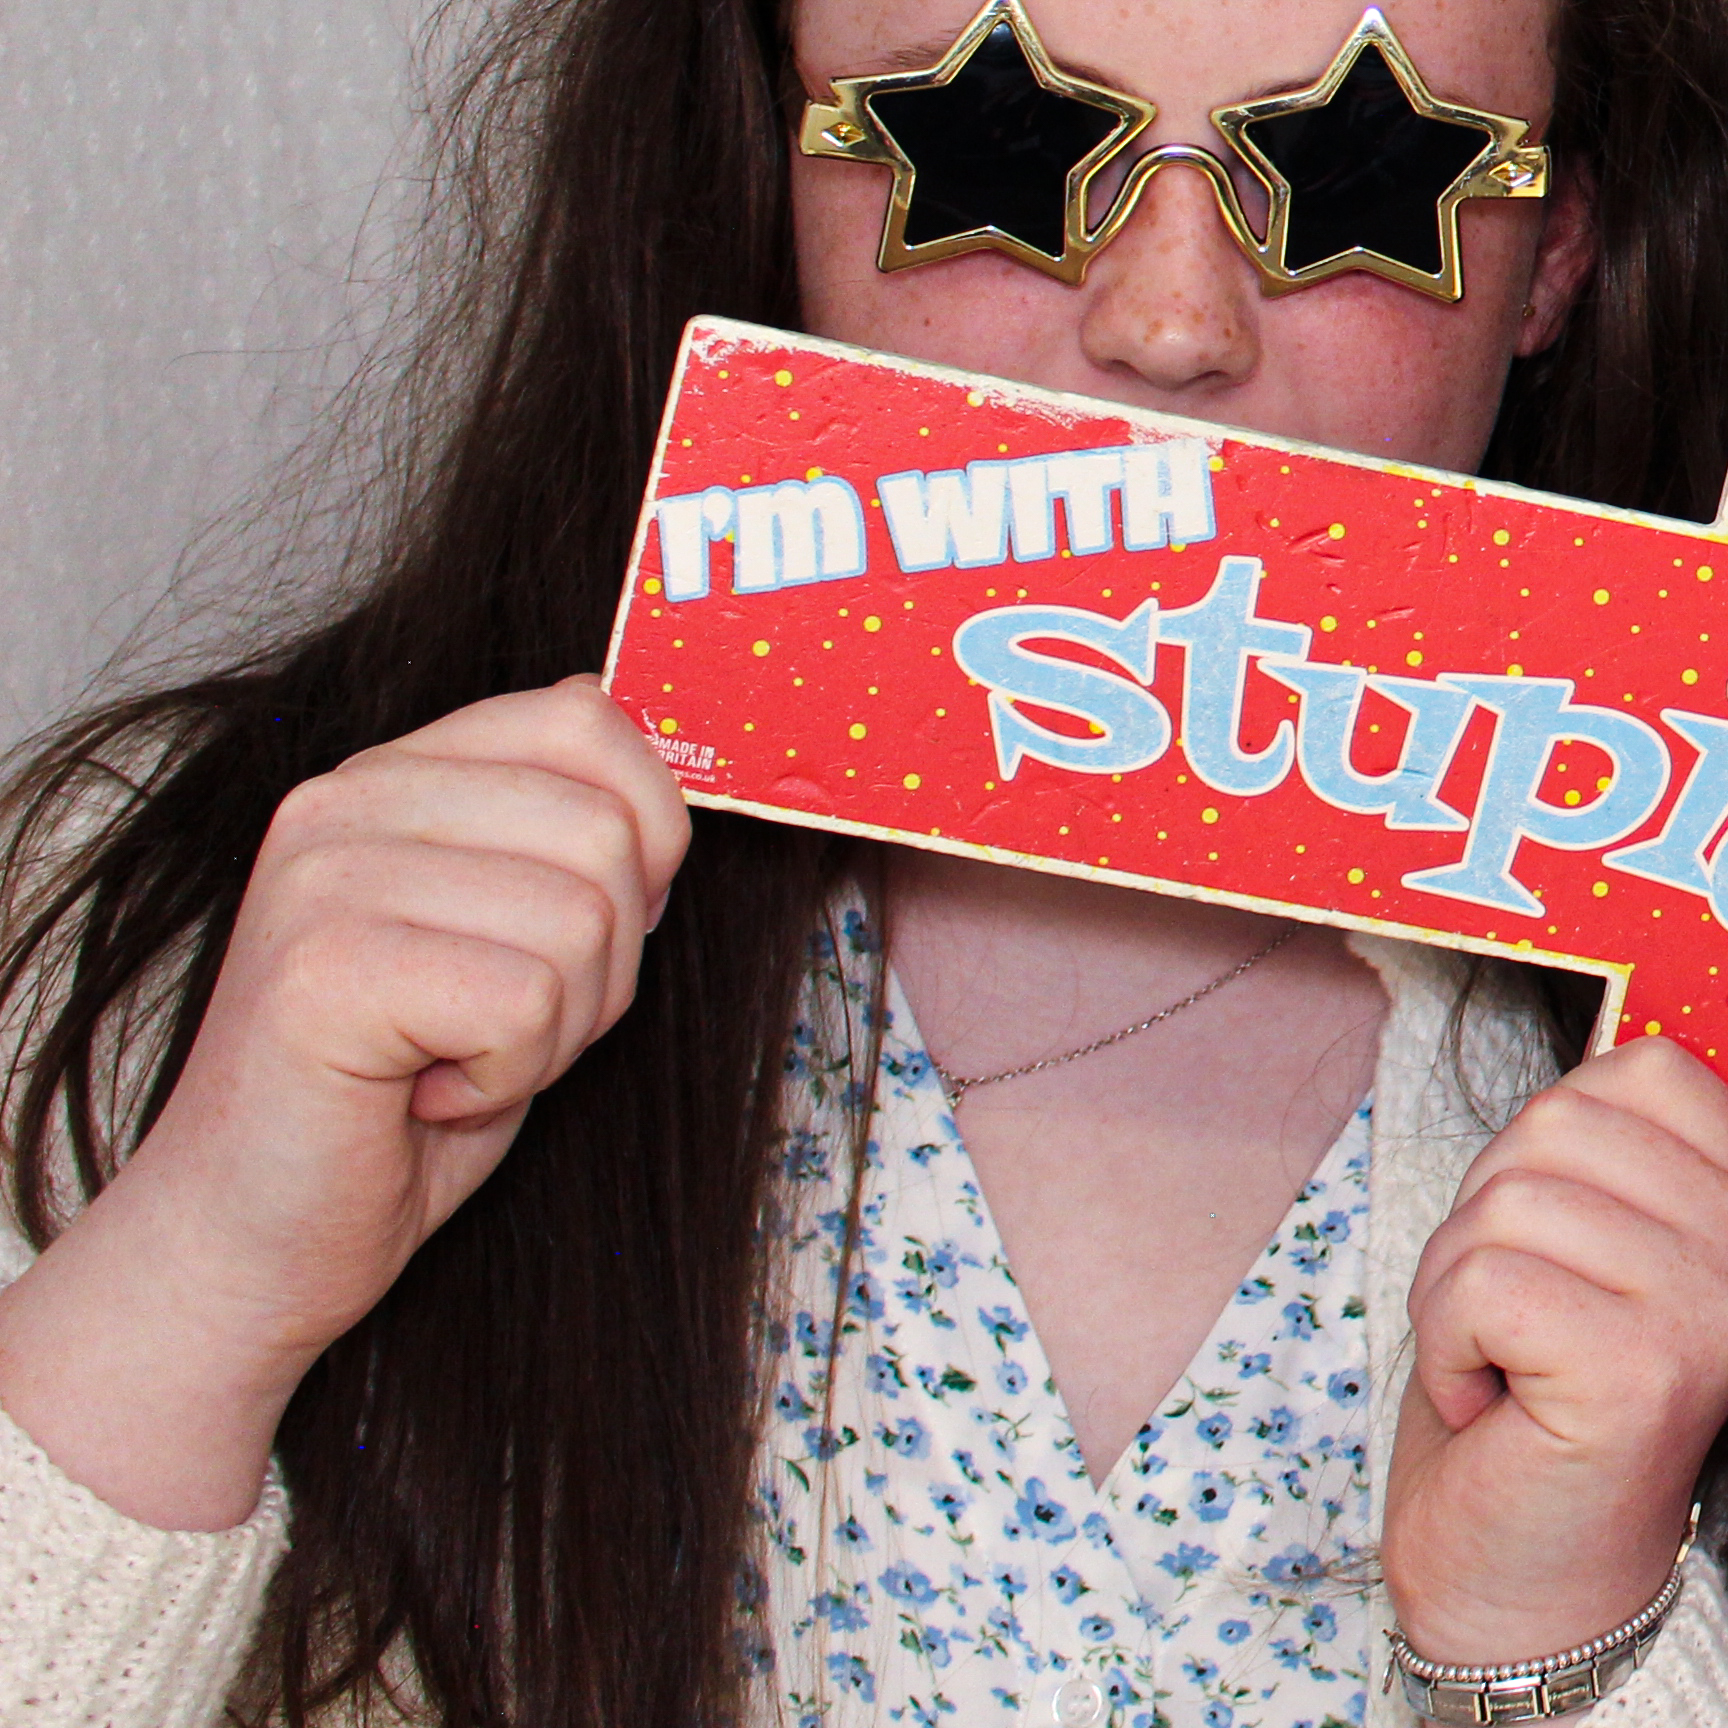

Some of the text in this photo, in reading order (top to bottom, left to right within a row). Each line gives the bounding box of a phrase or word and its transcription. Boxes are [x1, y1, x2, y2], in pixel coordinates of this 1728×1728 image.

[876, 438, 1217, 573] WITH
[659, 737, 715, 759] MADE IN
